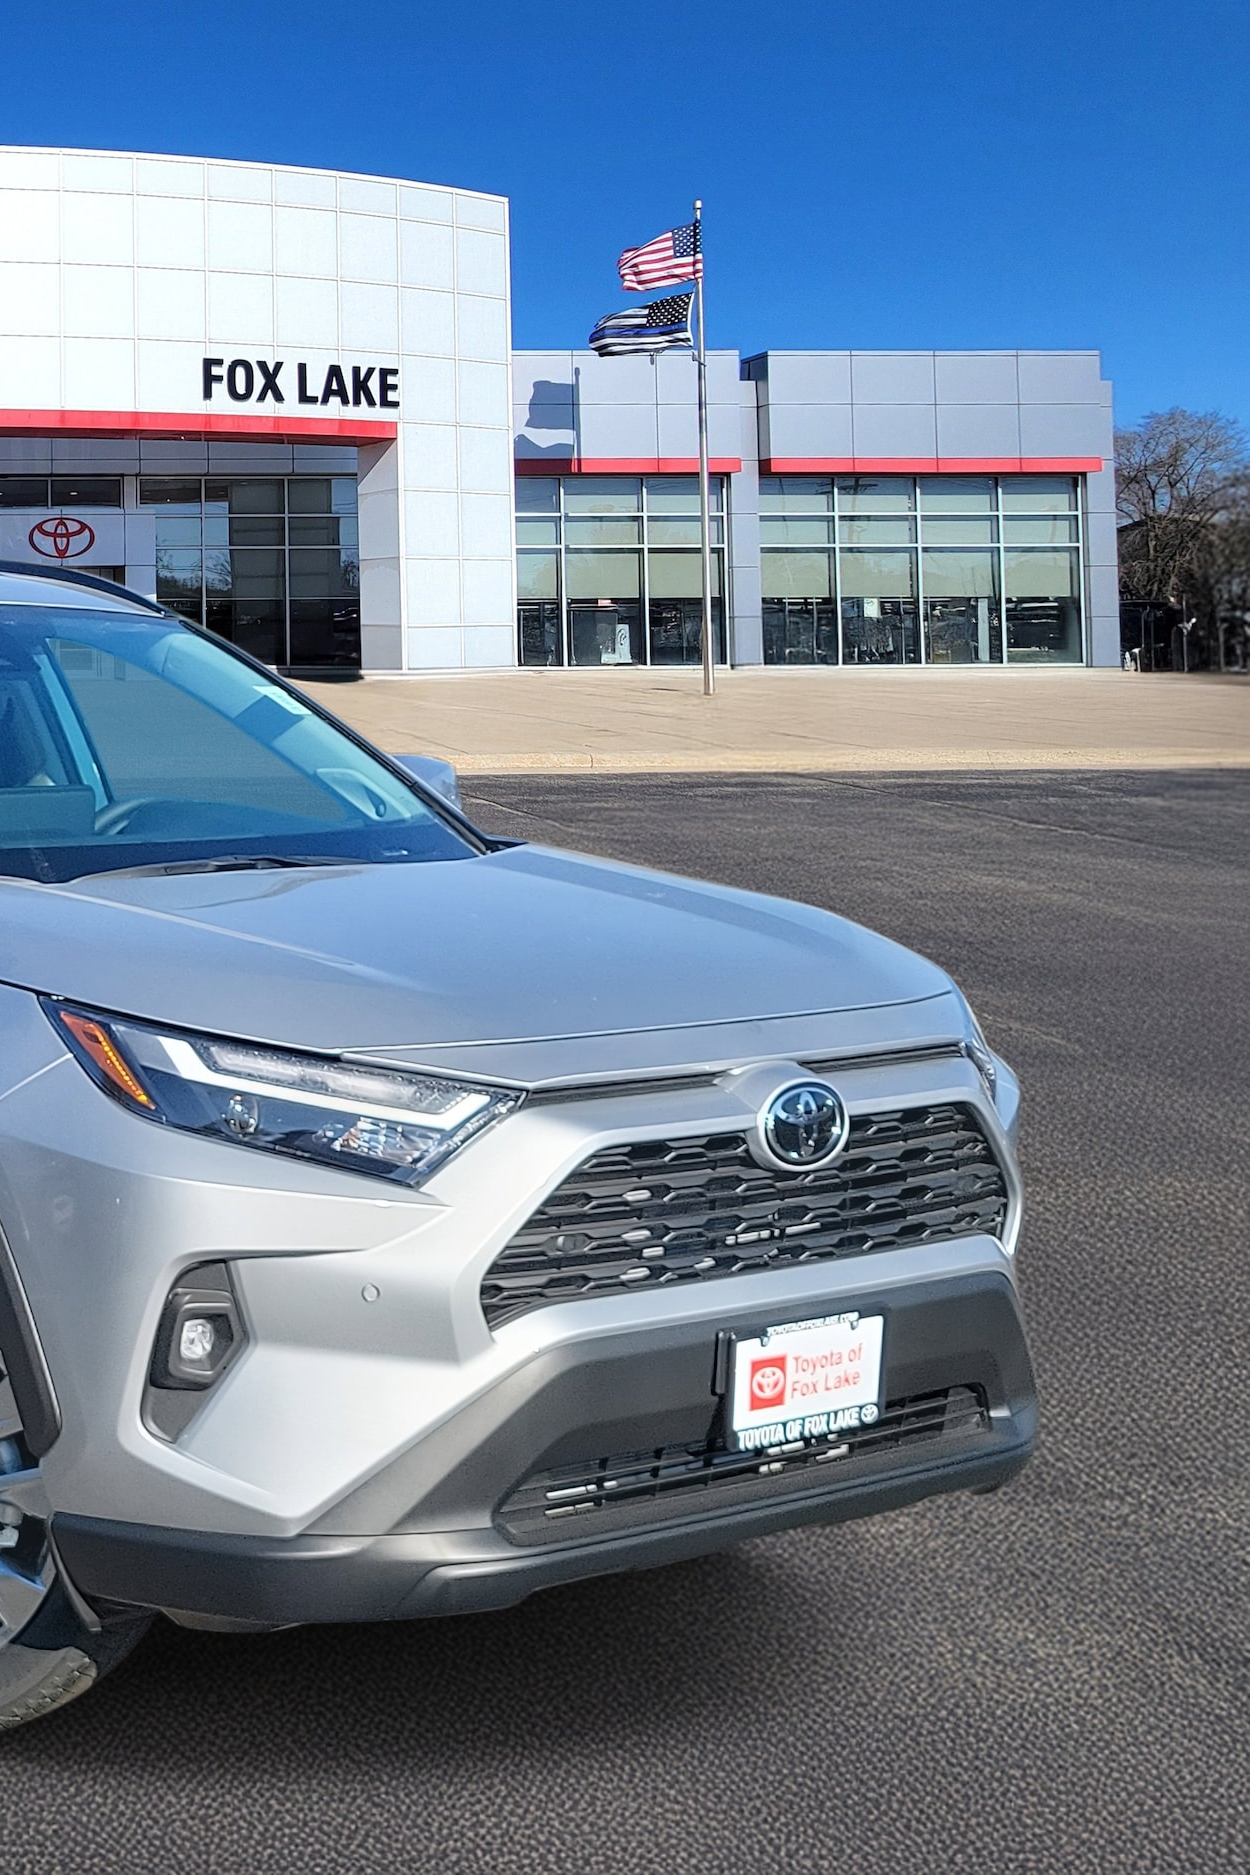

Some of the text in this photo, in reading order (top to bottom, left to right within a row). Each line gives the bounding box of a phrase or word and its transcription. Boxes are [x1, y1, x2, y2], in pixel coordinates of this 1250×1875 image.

[202, 357, 400, 408] FOX LAKE
[792, 1342, 862, 1376] Toyota of
[791, 1370, 860, 1399] Fox Lake
[737, 1406, 861, 1451] TOYOTA OF FOX LAKE
